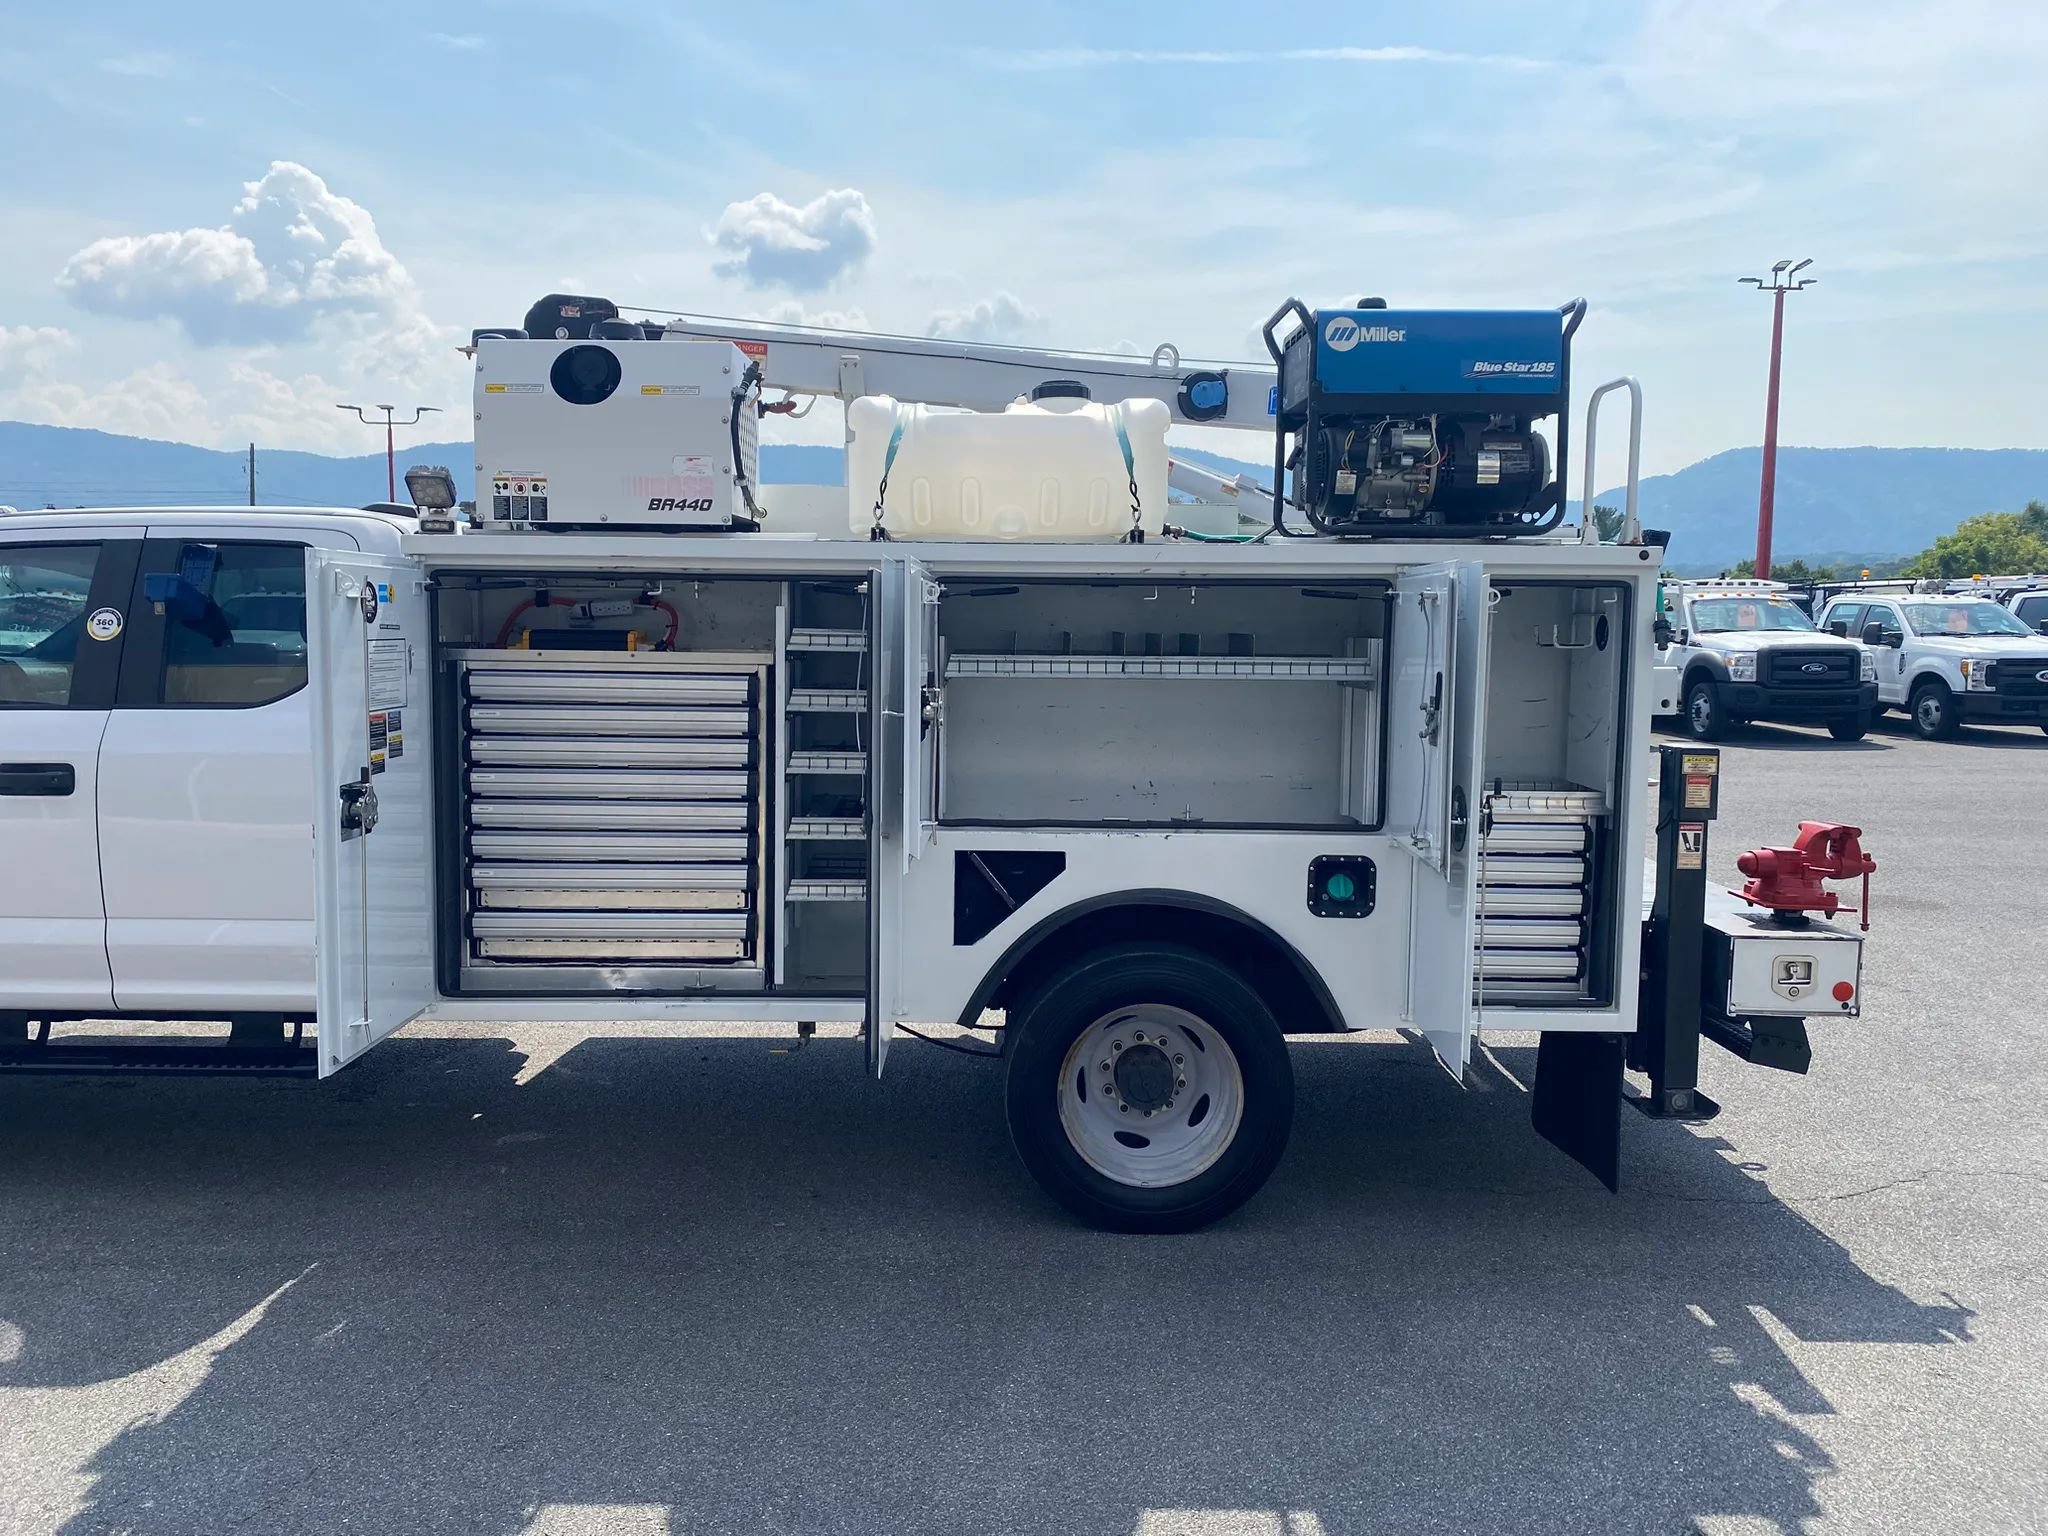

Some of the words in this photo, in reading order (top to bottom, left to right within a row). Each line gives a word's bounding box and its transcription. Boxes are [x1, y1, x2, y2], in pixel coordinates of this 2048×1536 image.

[1360, 326, 1406, 342] Miller
[1473, 361, 1503, 372] Blue
[648, 498, 713, 512] BA440
